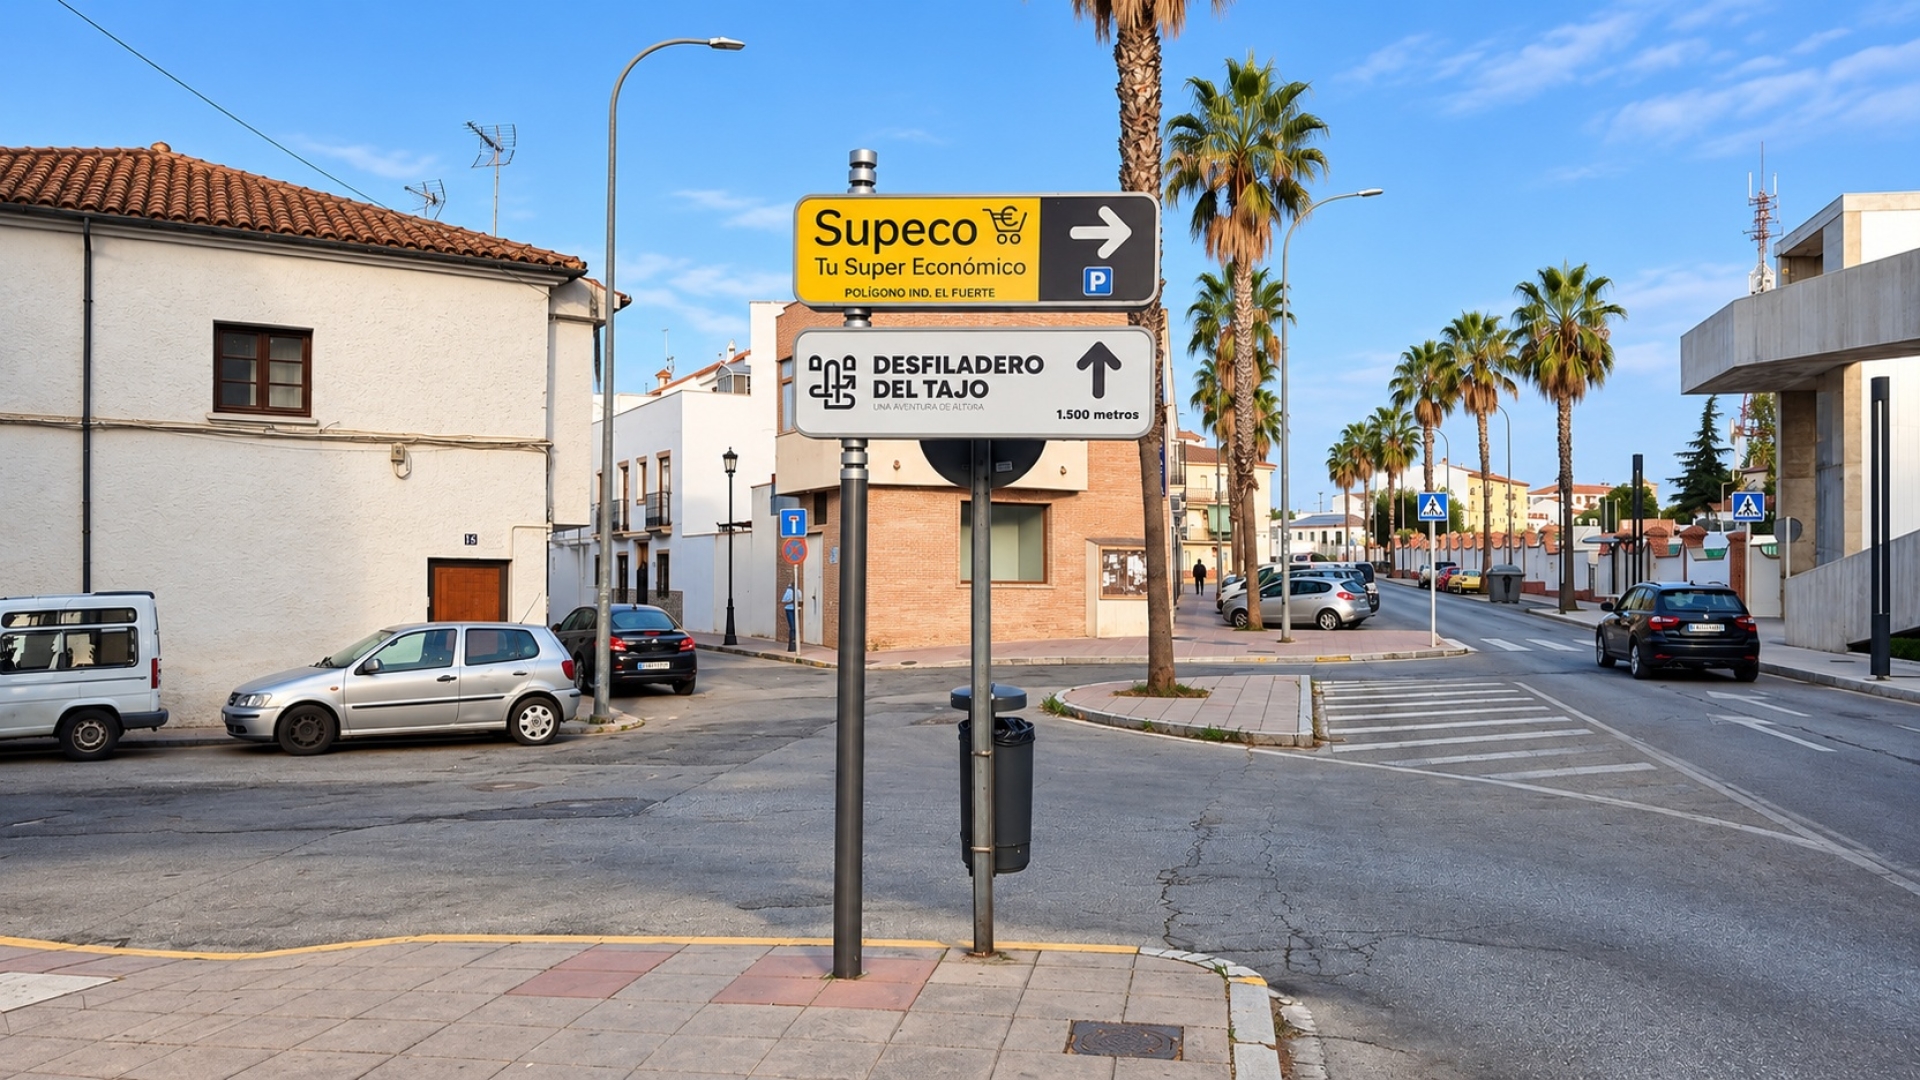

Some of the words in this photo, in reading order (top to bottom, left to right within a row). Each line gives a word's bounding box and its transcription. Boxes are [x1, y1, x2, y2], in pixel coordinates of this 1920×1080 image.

[814, 209, 978, 254] Supeco
[815, 257, 838, 275] Tu
[845, 257, 906, 279] Super
[912, 257, 1026, 275] Económico
[1089, 271, 1106, 291] P
[845, 286, 906, 298] POLÍGONO
[908, 288, 932, 298] IND.
[935, 288, 948, 298] EL
[951, 288, 995, 298] FUERTE
[873, 355, 1044, 374] DESFILADERO
[873, 380, 919, 398] DEL
[922, 379, 989, 398] TAJO
[873, 403, 891, 411] UNA
[892, 403, 937, 411] AVENTURA
[1056, 410, 1089, 420] 1.500
[1093, 410, 1140, 420] metros
